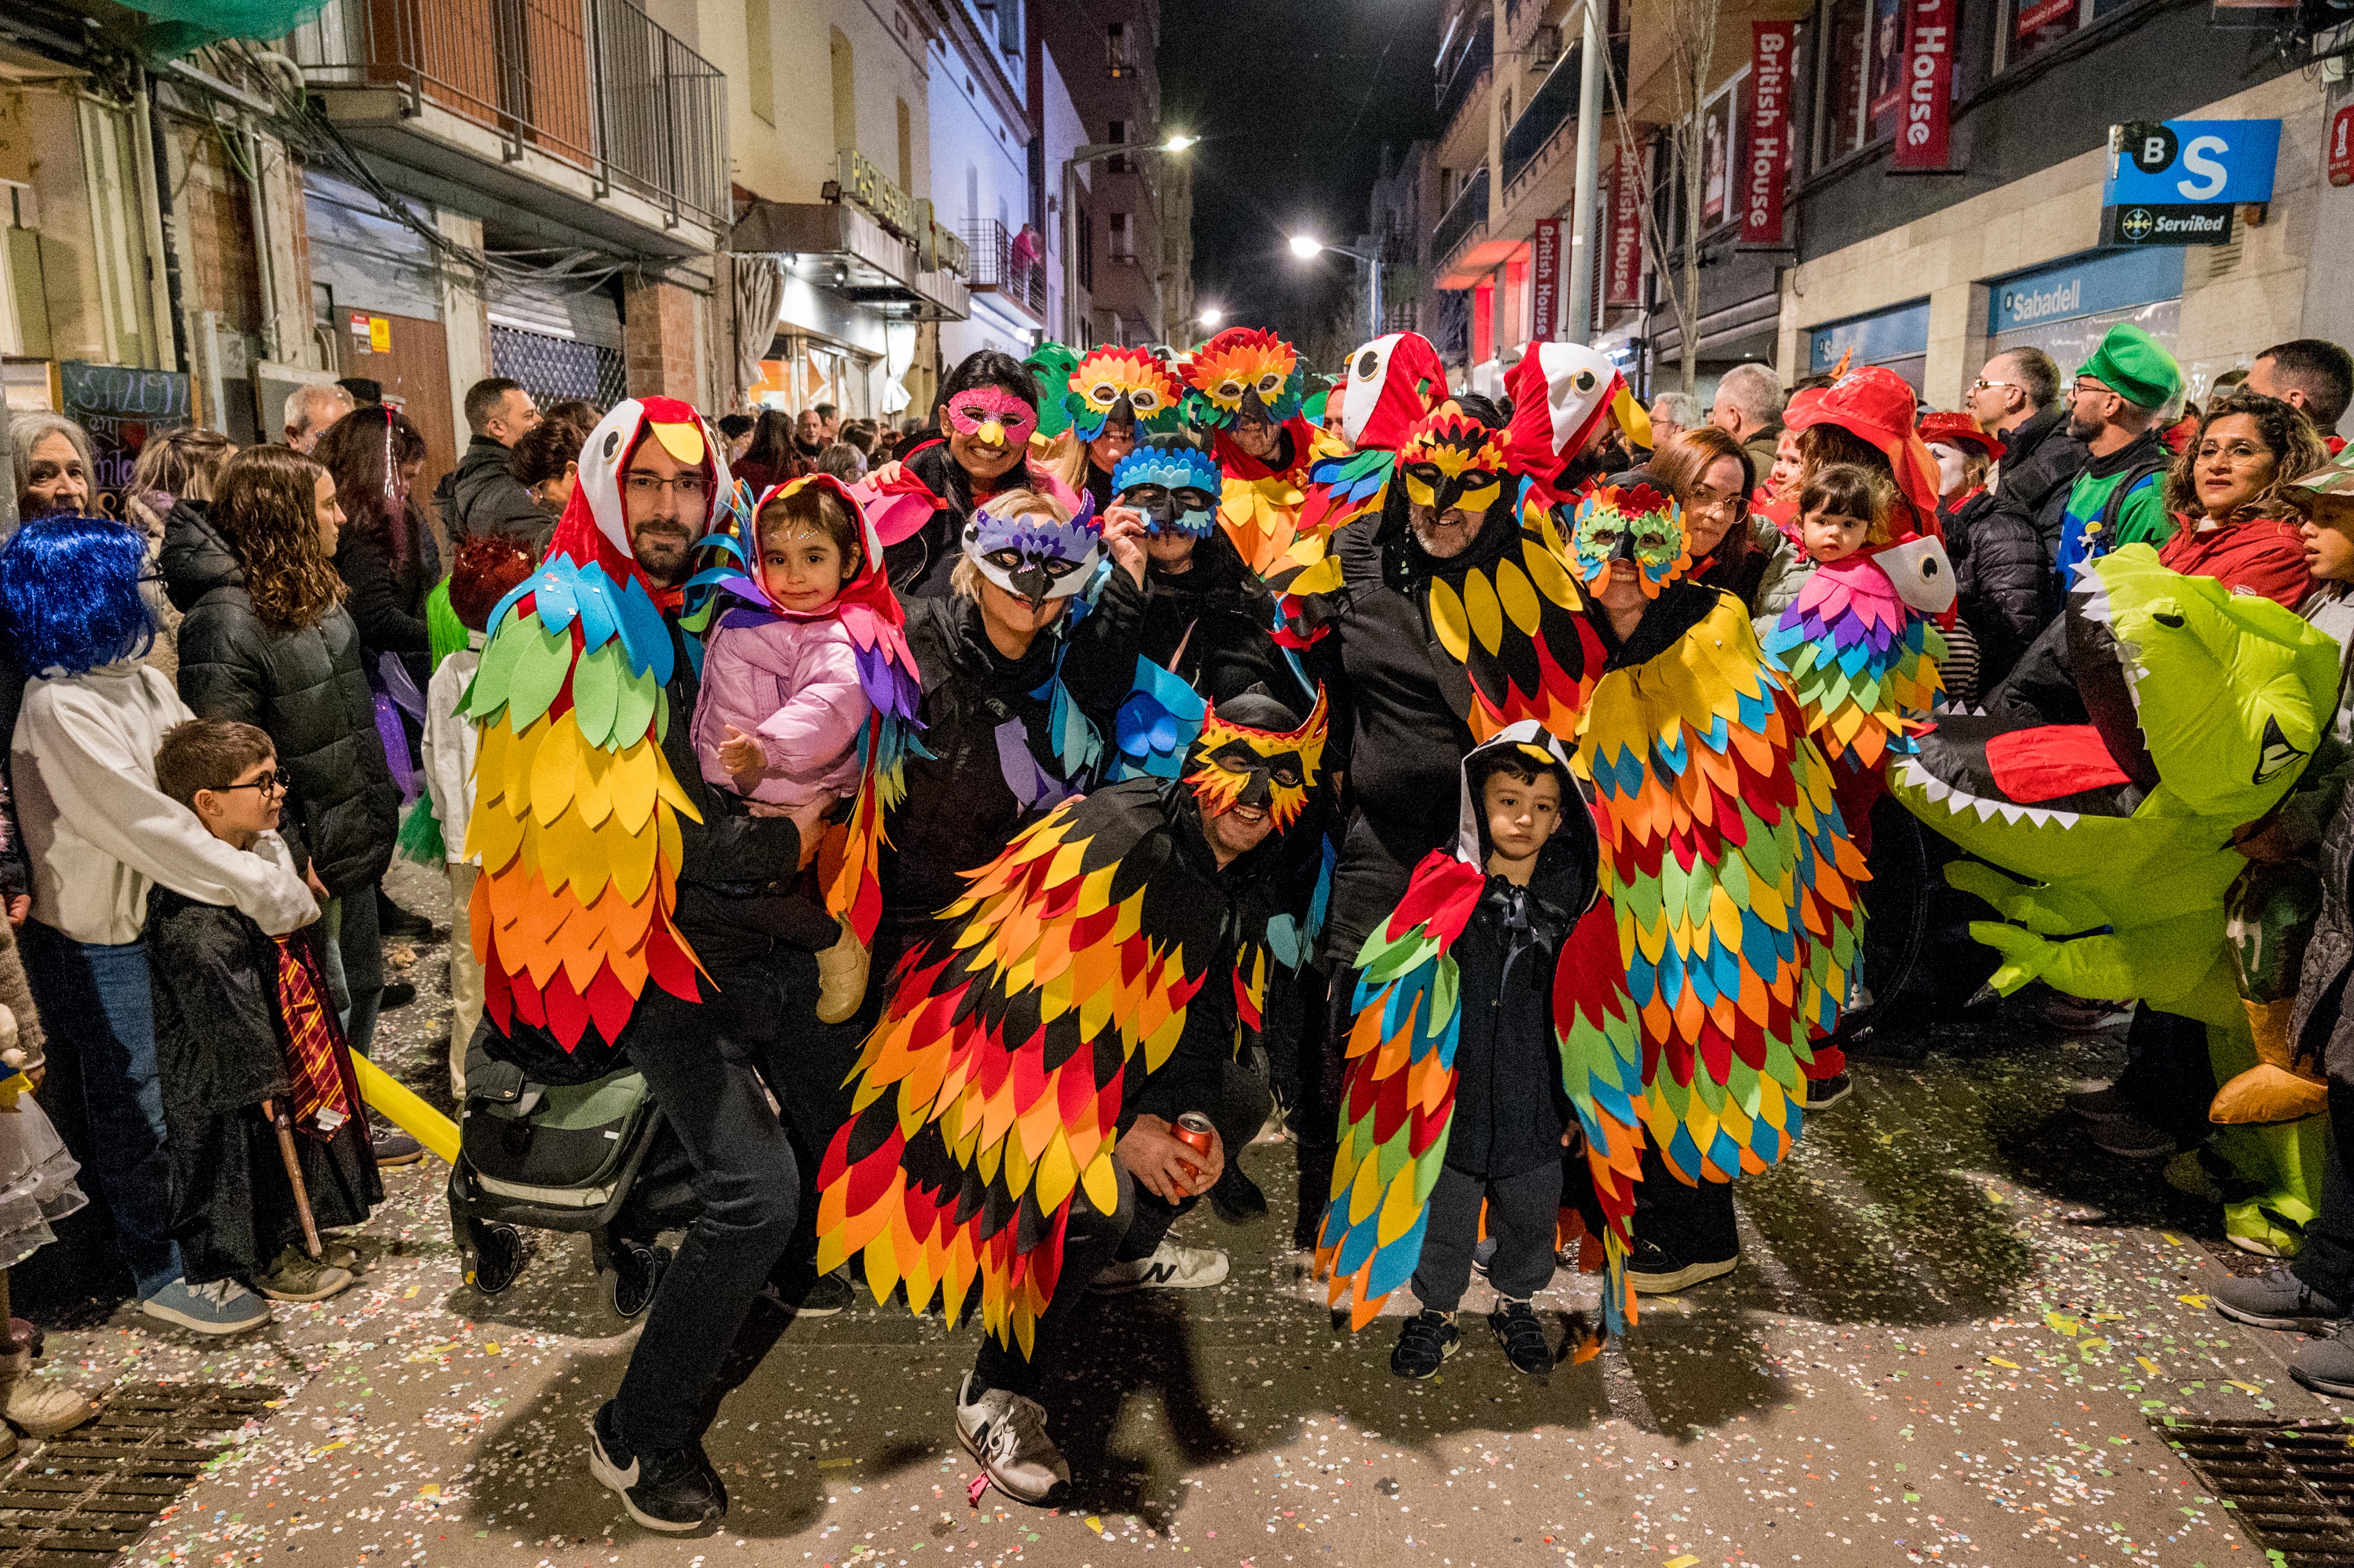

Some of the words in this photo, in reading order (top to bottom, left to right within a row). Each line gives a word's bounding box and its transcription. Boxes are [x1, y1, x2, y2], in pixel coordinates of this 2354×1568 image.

[1757, 33, 1785, 127] British
[1907, 27, 1947, 146] House
[1618, 151, 1639, 221] British
[1750, 137, 1779, 227] House
[2177, 135, 2229, 201] S
[1538, 225, 1554, 279] British
[2155, 215, 2225, 232] ServiRed
[1615, 228, 1636, 292] House
[1536, 284, 1552, 335] House
[2012, 279, 2080, 322] Sabadell
